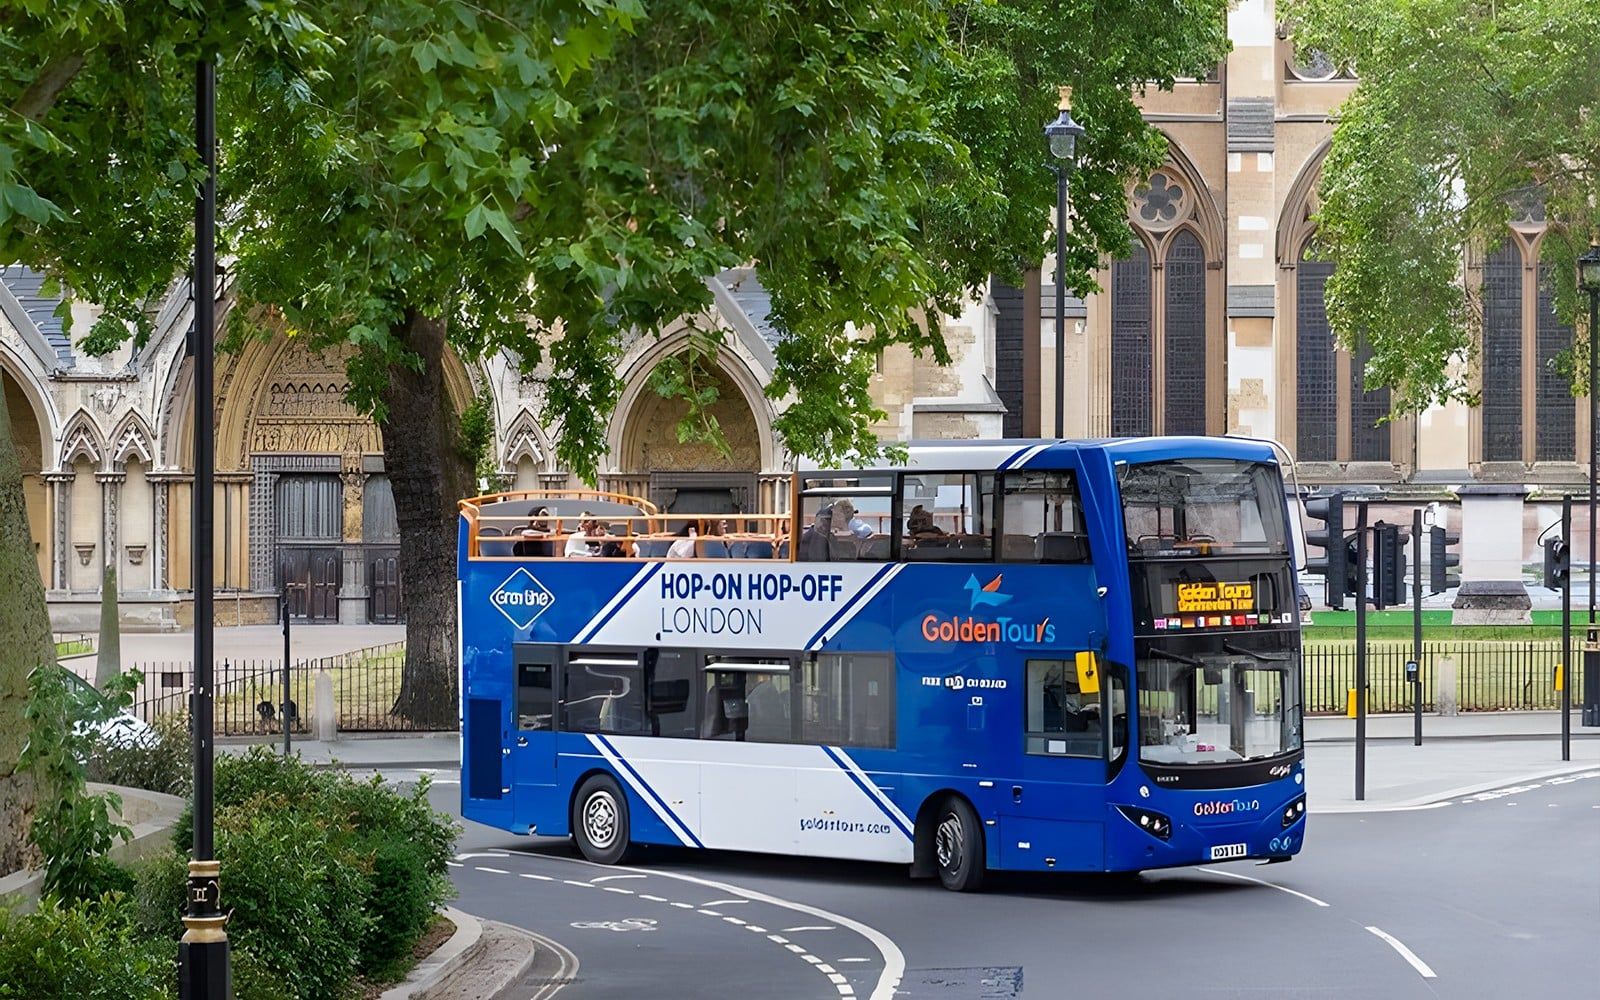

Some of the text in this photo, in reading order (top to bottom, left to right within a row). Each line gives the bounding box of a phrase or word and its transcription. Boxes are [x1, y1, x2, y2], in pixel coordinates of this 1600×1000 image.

[661, 573, 843, 602] HOP-ON HOP-OFF
[661, 606, 762, 635] LONDON
